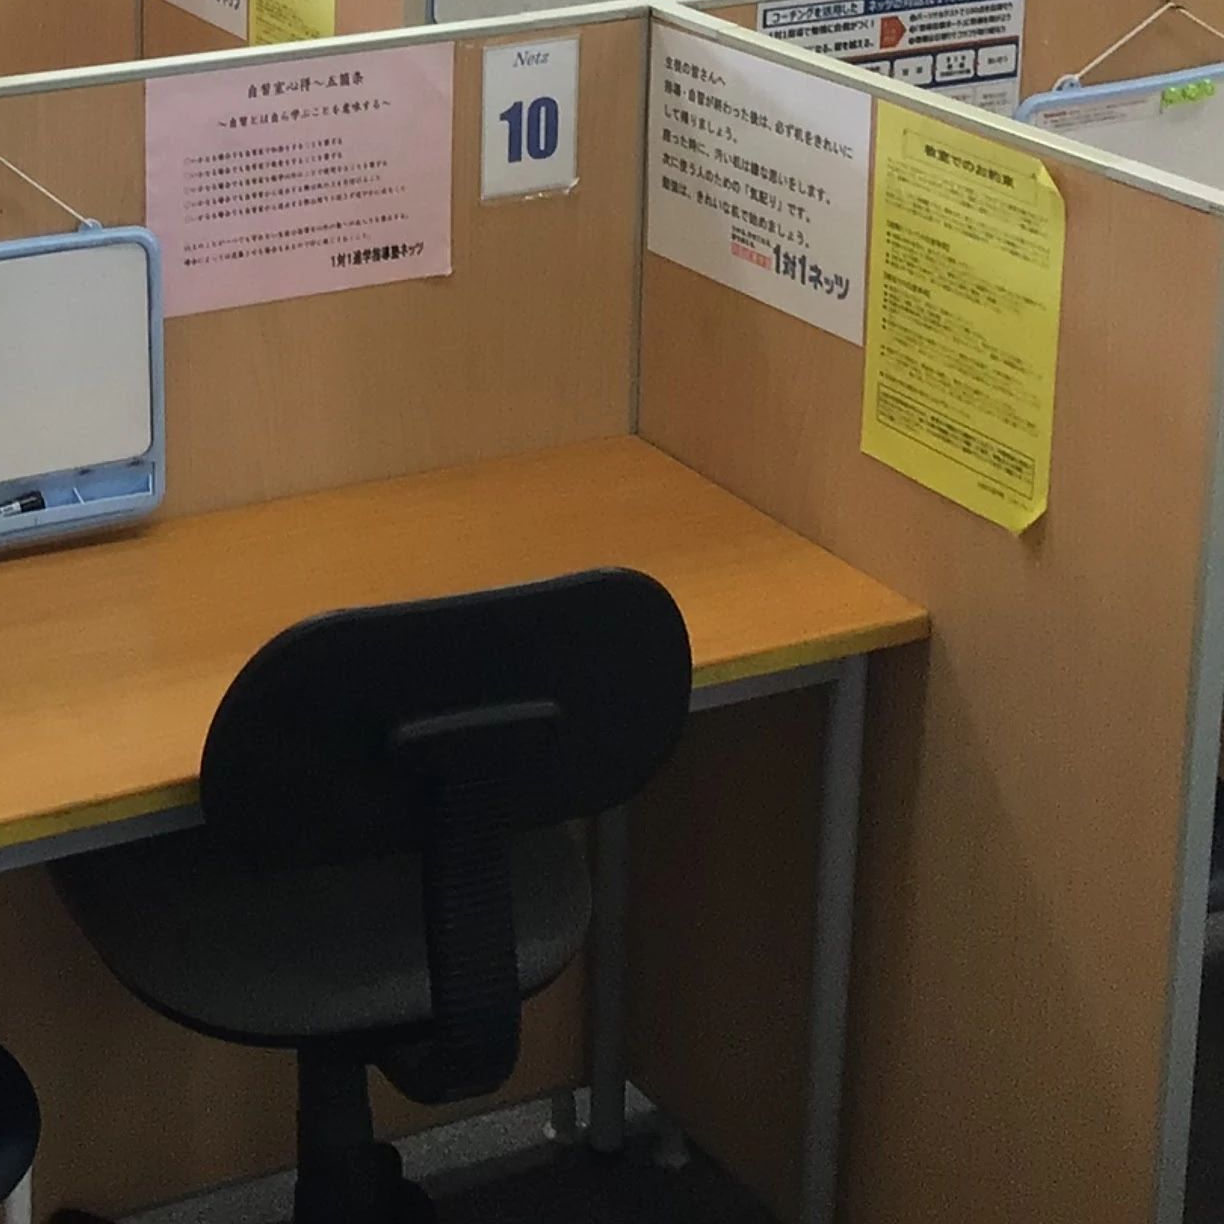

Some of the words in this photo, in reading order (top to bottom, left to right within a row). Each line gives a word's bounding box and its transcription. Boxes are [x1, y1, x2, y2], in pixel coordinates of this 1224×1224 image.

[499, 96, 559, 164] 10
[772, 244, 851, 300] 1対1ネッツ
